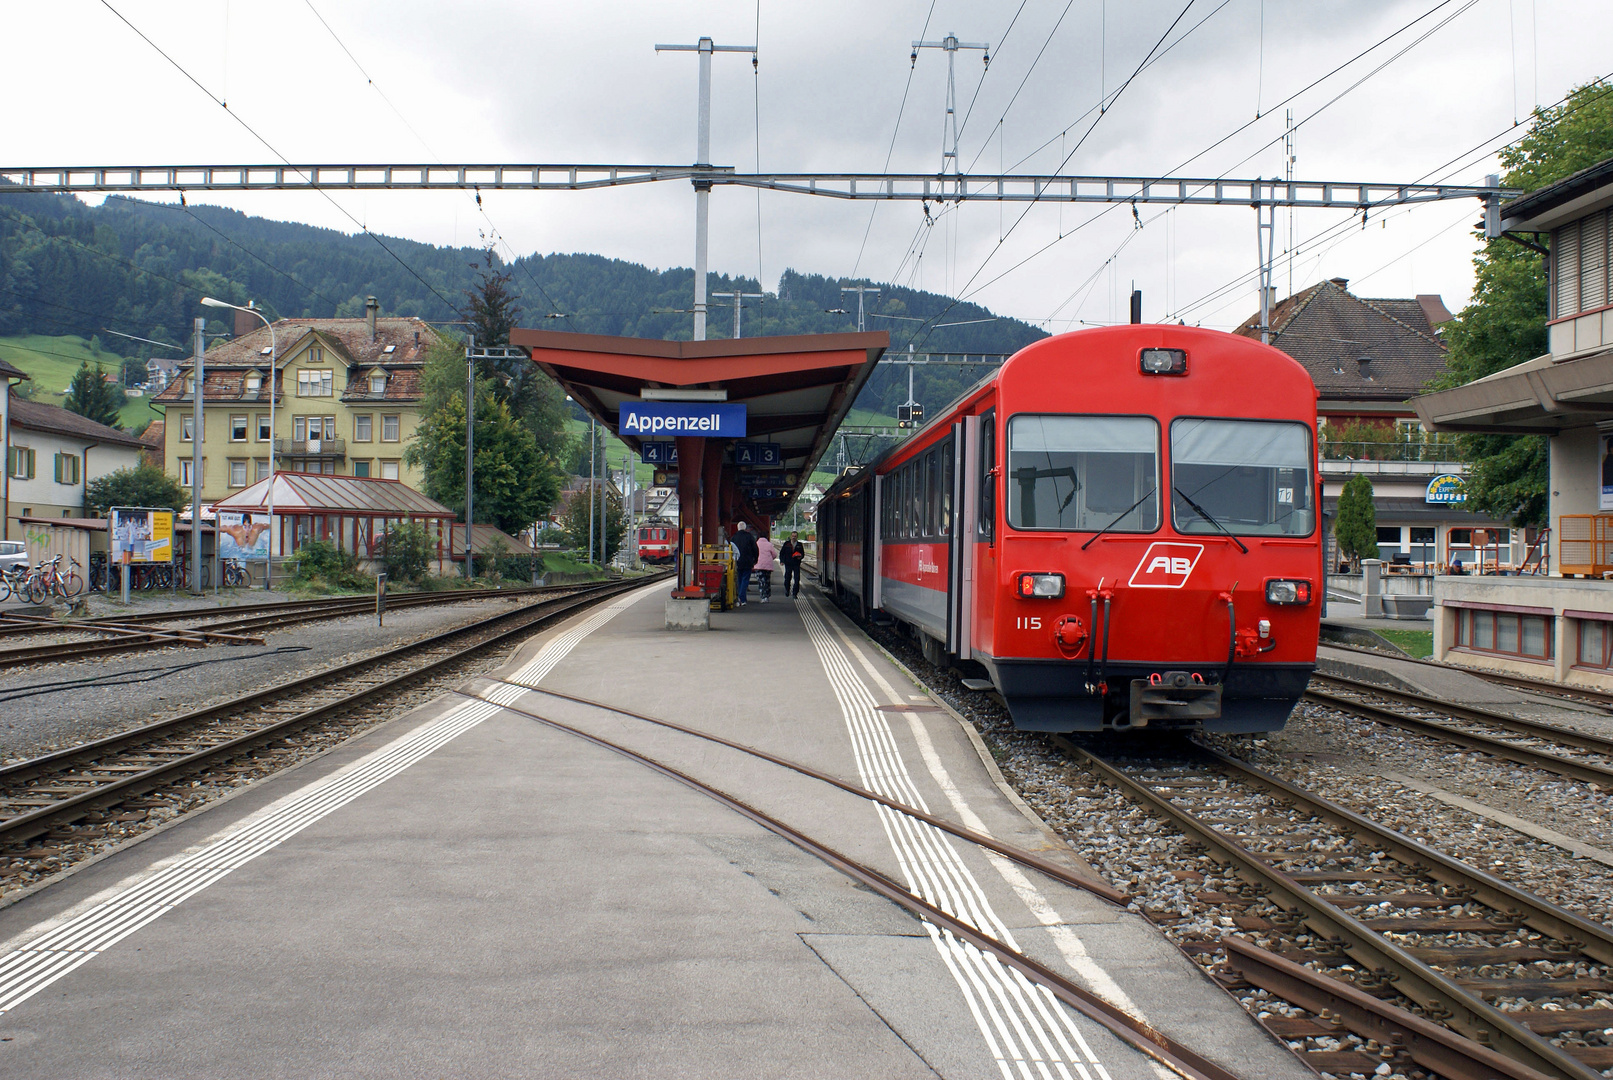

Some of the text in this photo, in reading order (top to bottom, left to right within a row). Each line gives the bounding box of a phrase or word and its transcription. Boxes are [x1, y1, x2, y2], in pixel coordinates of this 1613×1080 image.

[625, 412, 720, 433] Appenzell
[648, 448, 678, 460] 4 A
[741, 449, 774, 462] A 3
[752, 488, 772, 496] A 3
[1429, 493, 1468, 501] BUFFET
[1146, 556, 1191, 575] AB
[1017, 617, 1042, 630] 115
